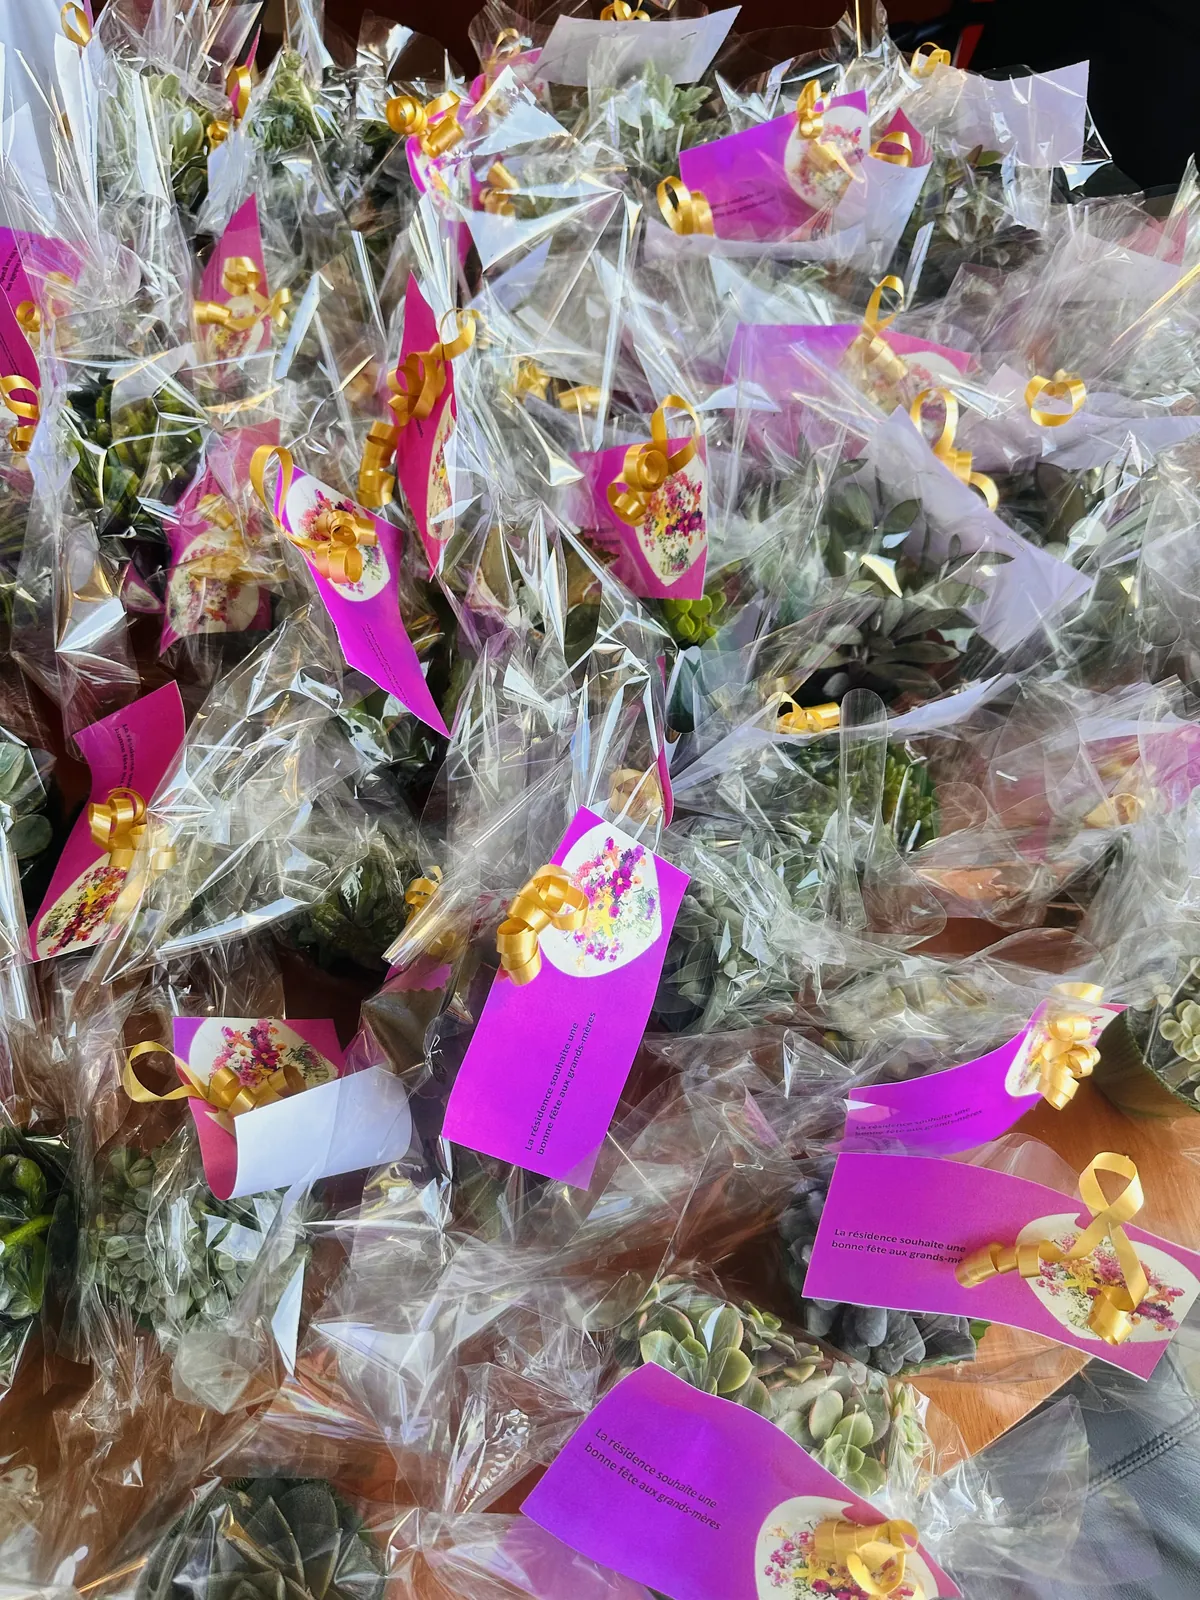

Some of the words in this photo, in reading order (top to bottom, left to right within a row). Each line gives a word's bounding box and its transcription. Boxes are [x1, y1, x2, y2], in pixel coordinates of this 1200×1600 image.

[525, 1139, 534, 1152] La
[530, 1087, 554, 1137] résidence
[550, 1043, 571, 1086] souhaite
[568, 1022, 580, 1042] une
[536, 1122, 554, 1156] bonne
[548, 1100, 562, 1121] fête
[559, 1080, 571, 1098] aux
[568, 1012, 596, 1079] grands-mères
[831, 1240, 864, 1251] bonne
[866, 1244, 887, 1254] fête
[889, 1248, 907, 1257] aux
[909, 1250, 964, 1264] grands-mè
[834, 1228, 846, 1236] La
[848, 1230, 898, 1243] résidence
[899, 1235, 944, 1250] souhaite
[946, 1244, 966, 1253] une
[584, 1442, 617, 1470] bonne
[618, 1466, 639, 1486] fête
[638, 1483, 658, 1497] aux
[656, 1493, 722, 1530] grands-mères
[595, 1428, 607, 1441] La
[608, 1438, 656, 1475] résidence
[656, 1472, 698, 1498] souhaite
[698, 1492, 718, 1508] une
